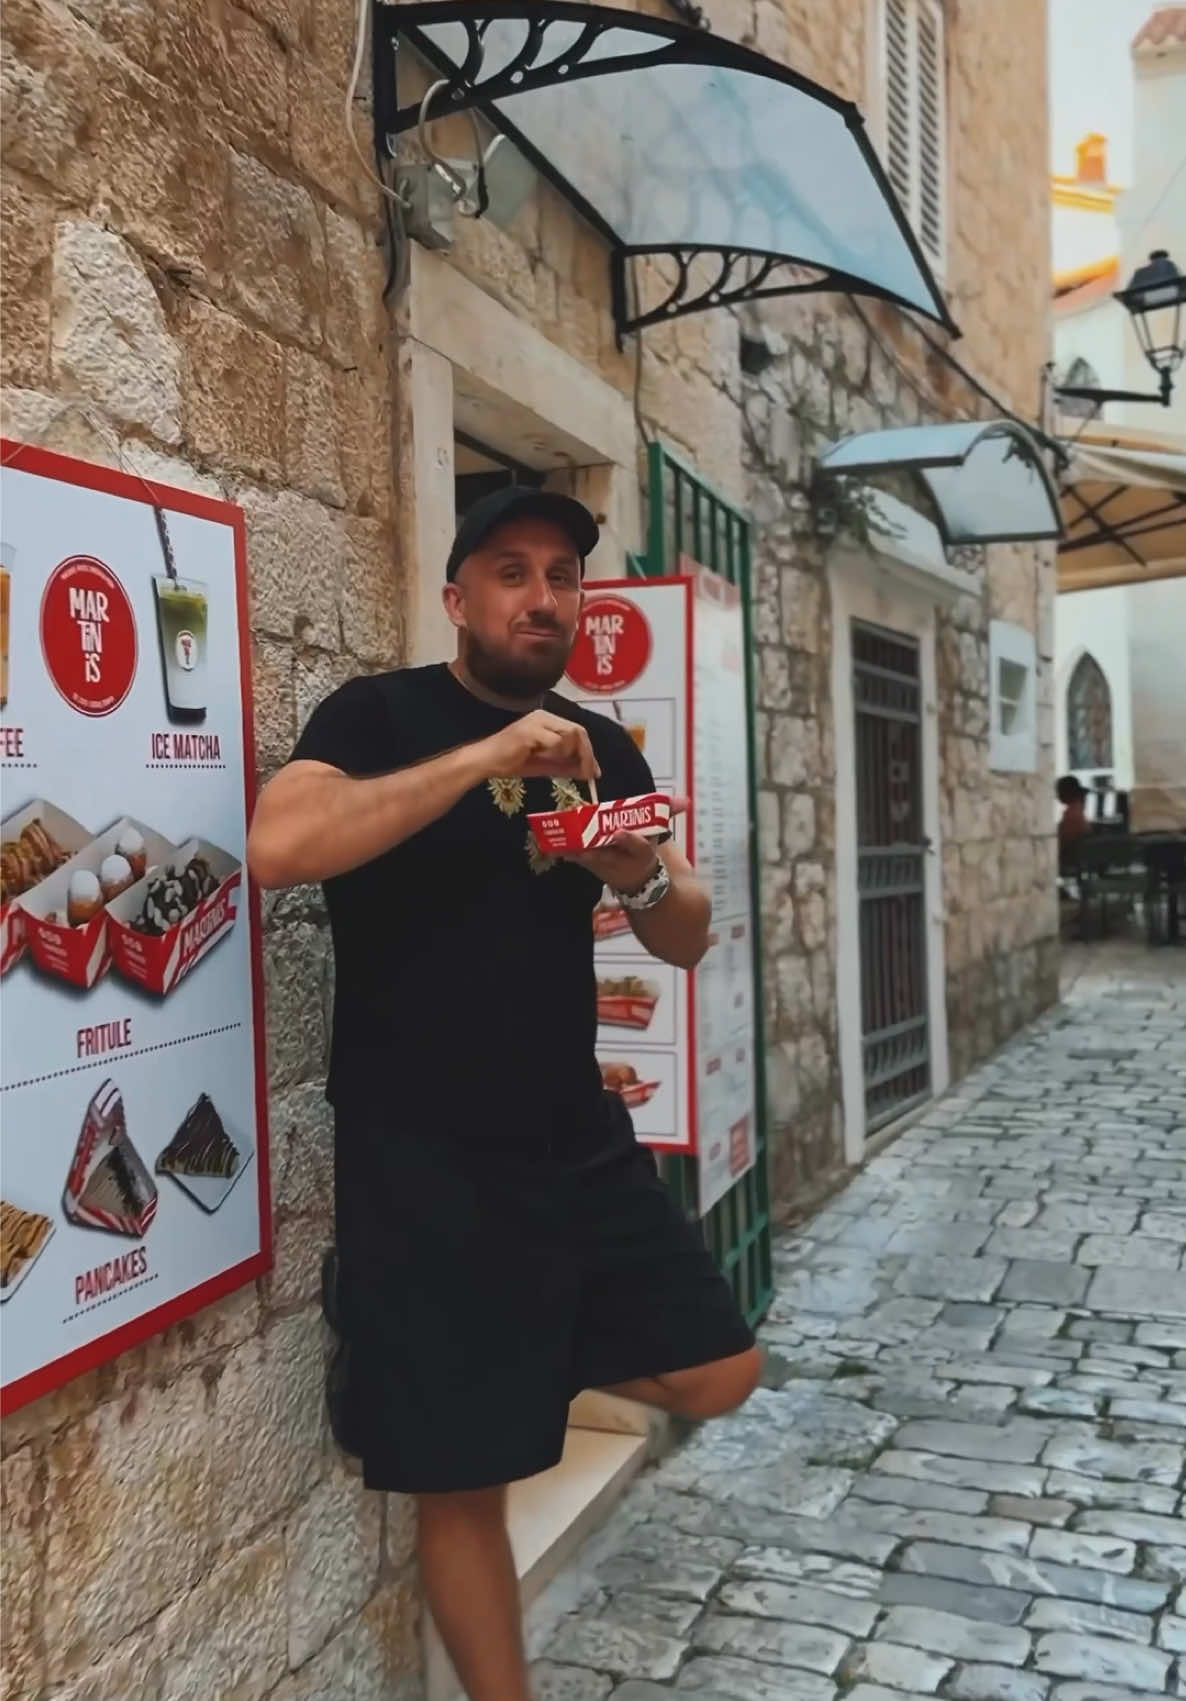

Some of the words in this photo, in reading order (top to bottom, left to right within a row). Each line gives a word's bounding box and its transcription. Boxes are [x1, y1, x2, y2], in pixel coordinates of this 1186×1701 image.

[69, 587, 110, 623] MAR
[585, 614, 624, 636] MAR
[152, 733, 170, 759] ICE
[173, 733, 221, 760] MATCHA
[77, 1018, 132, 1058] FRITULE
[76, 1246, 147, 1304] PANCAKES
